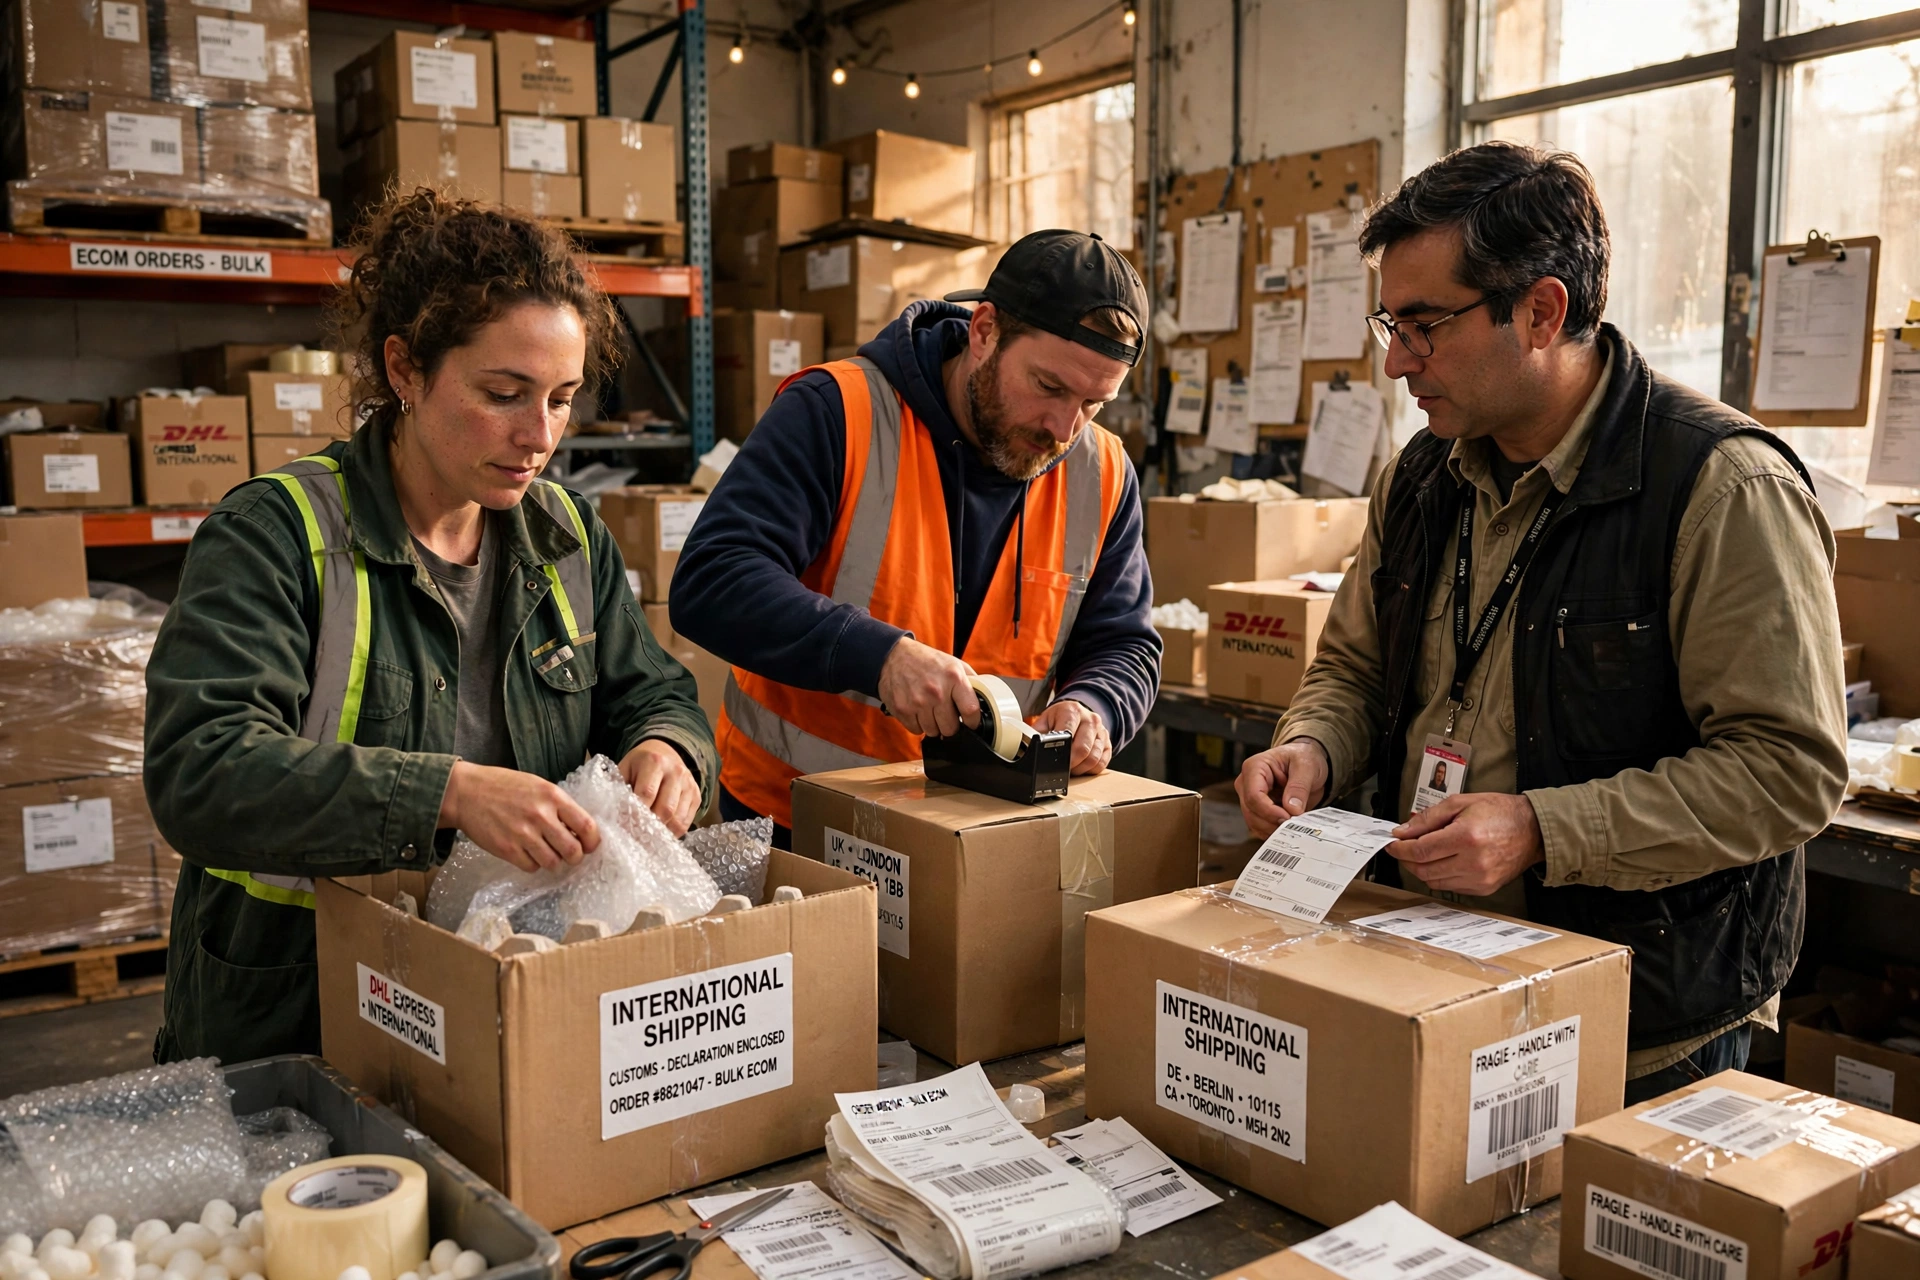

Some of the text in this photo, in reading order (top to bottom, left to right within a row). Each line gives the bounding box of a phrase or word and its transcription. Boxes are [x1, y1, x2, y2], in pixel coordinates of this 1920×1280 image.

[77, 248, 128, 265] ECOM
[135, 251, 204, 270] ORDERS
[221, 255, 266, 272] BULK
[163, 425, 229, 440] DHL
[1222, 638, 1295, 659] INTERNATIONAL
[1224, 612, 1288, 638] DHL
[831, 835, 845, 854] UK
[857, 845, 901, 876] LONDON
[885, 877, 904, 898] 1BB
[370, 974, 436, 1027] DHL EXPRESS
[612, 967, 784, 1026] INTERNATIONAL
[368, 999, 439, 1056] INTERNATIONAL
[643, 1003, 746, 1047] SHIPPING
[1163, 992, 1300, 1059] INTERNATIONAL
[1518, 1032, 1553, 1058] HANDLE
[1554, 1024, 1576, 1045] WITH
[609, 1062, 658, 1087] CUSTOMS
[667, 1043, 734, 1072] DECLARATION
[737, 1029, 785, 1054] ENCLOSED
[1185, 1027, 1266, 1075] SHIPPING
[609, 1091, 650, 1114] ORDER
[652, 1077, 705, 1103] #8821047
[715, 1066, 744, 1087] BULK
[747, 1057, 777, 1078] ECOM
[1167, 1063, 1182, 1082] DE
[1194, 1074, 1234, 1102] BERLIN
[1248, 1094, 1281, 1119] 10115
[1165, 1084, 1178, 1102] CA
[1187, 1093, 1235, 1124] TORONTO
[1245, 1115, 1268, 1138] M5H
[1271, 1126, 1291, 1147] 2N2
[1640, 1210, 1683, 1239] HANDLE
[1685, 1227, 1712, 1250] WITH
[1713, 1239, 1743, 1263] CARE
